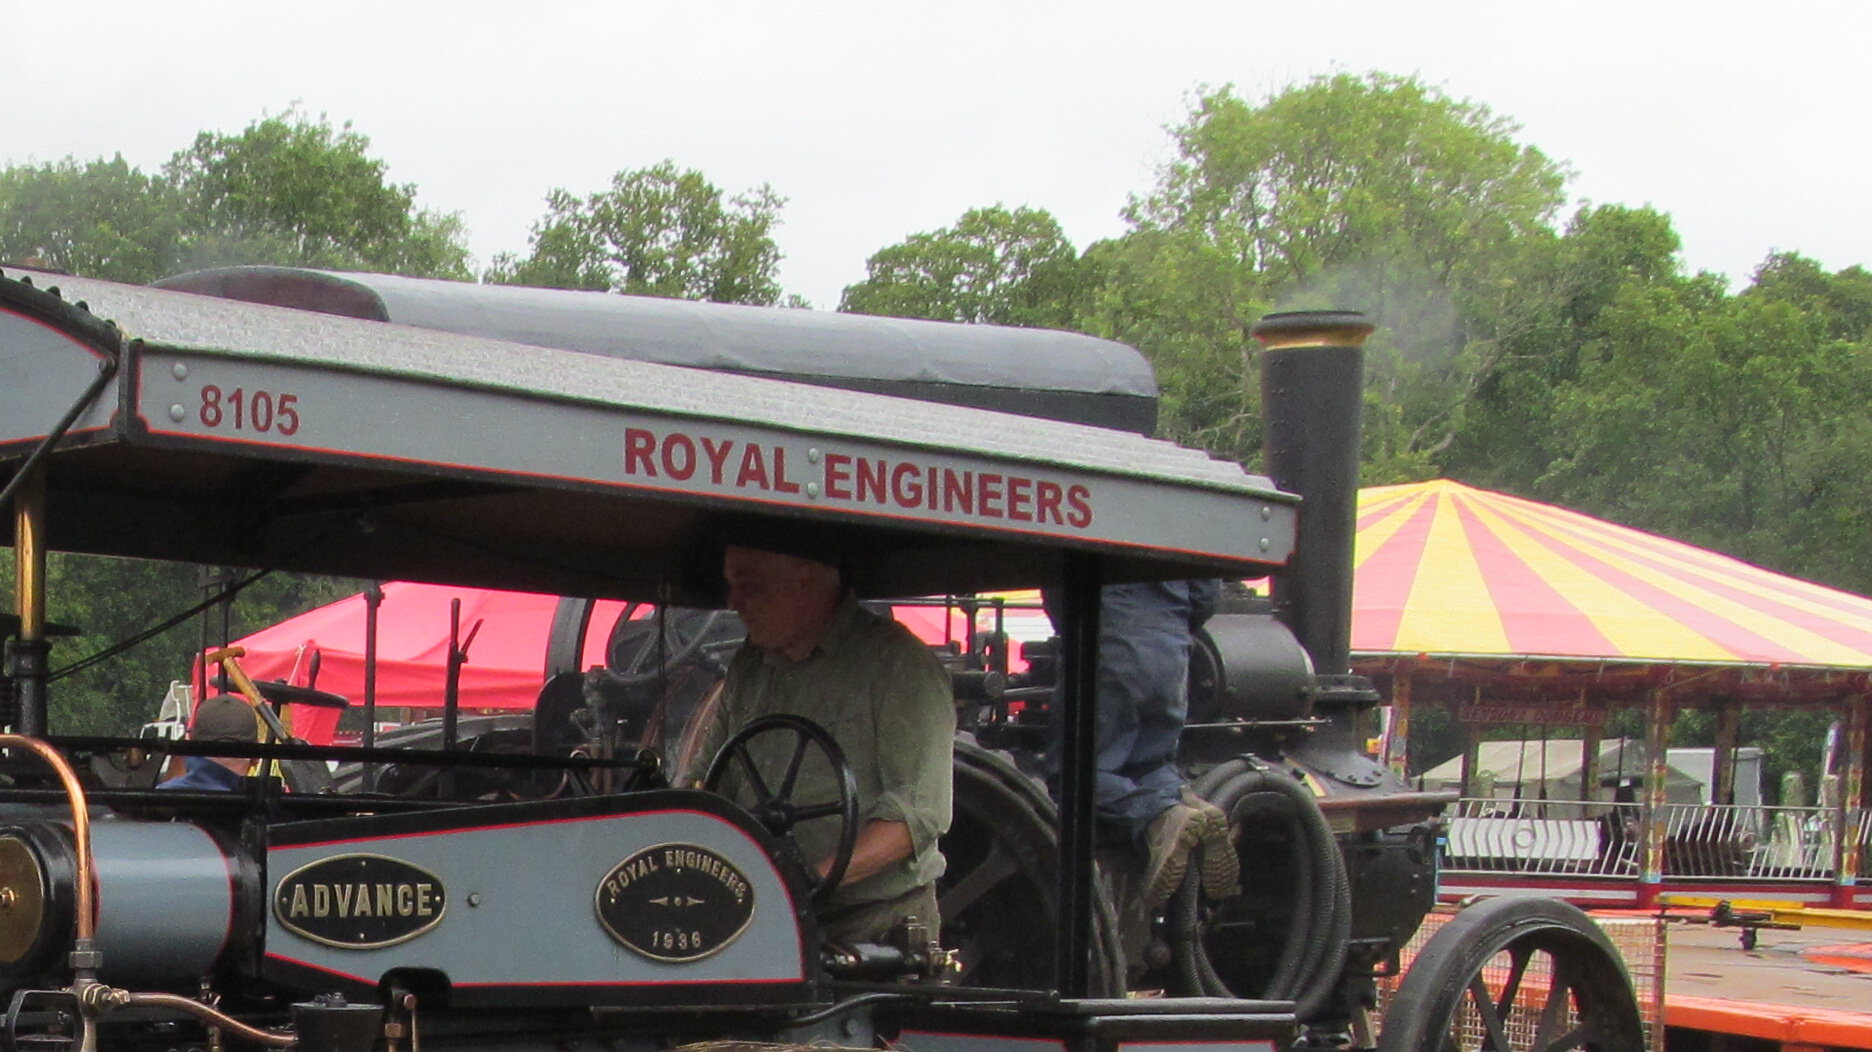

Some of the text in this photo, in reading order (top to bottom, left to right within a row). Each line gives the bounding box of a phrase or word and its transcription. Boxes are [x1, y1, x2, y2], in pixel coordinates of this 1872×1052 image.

[199, 385, 300, 436] 8105
[624, 427, 1093, 529] ROYAL ENGINEERS
[606, 850, 748, 898] ROYAL ENGINEERS
[290, 883, 433, 918] ADVANCE
